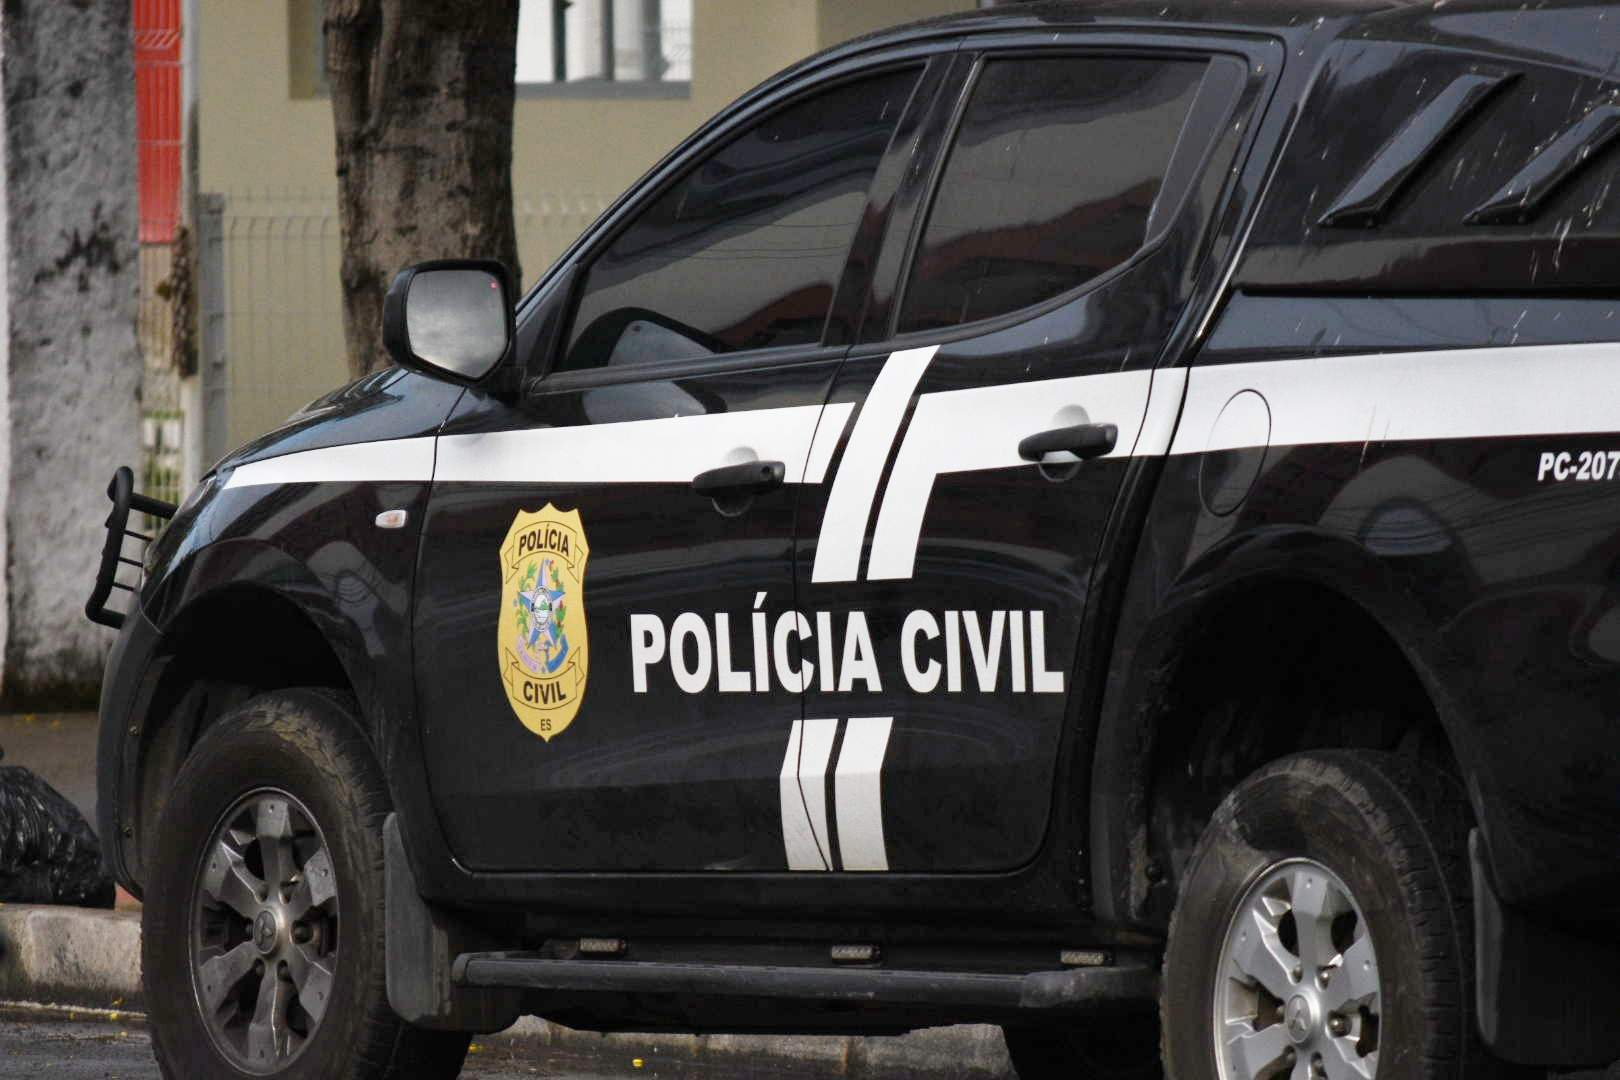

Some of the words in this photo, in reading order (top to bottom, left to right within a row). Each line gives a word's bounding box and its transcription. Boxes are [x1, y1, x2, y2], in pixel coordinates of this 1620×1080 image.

[1537, 451, 1620, 482] PC-207
[519, 524, 570, 557] POLÍCIA
[630, 592, 883, 694] POLÍCIA
[900, 609, 1065, 694] CIVIL
[523, 681, 567, 705] CIVIL
[540, 718, 552, 731] ES
